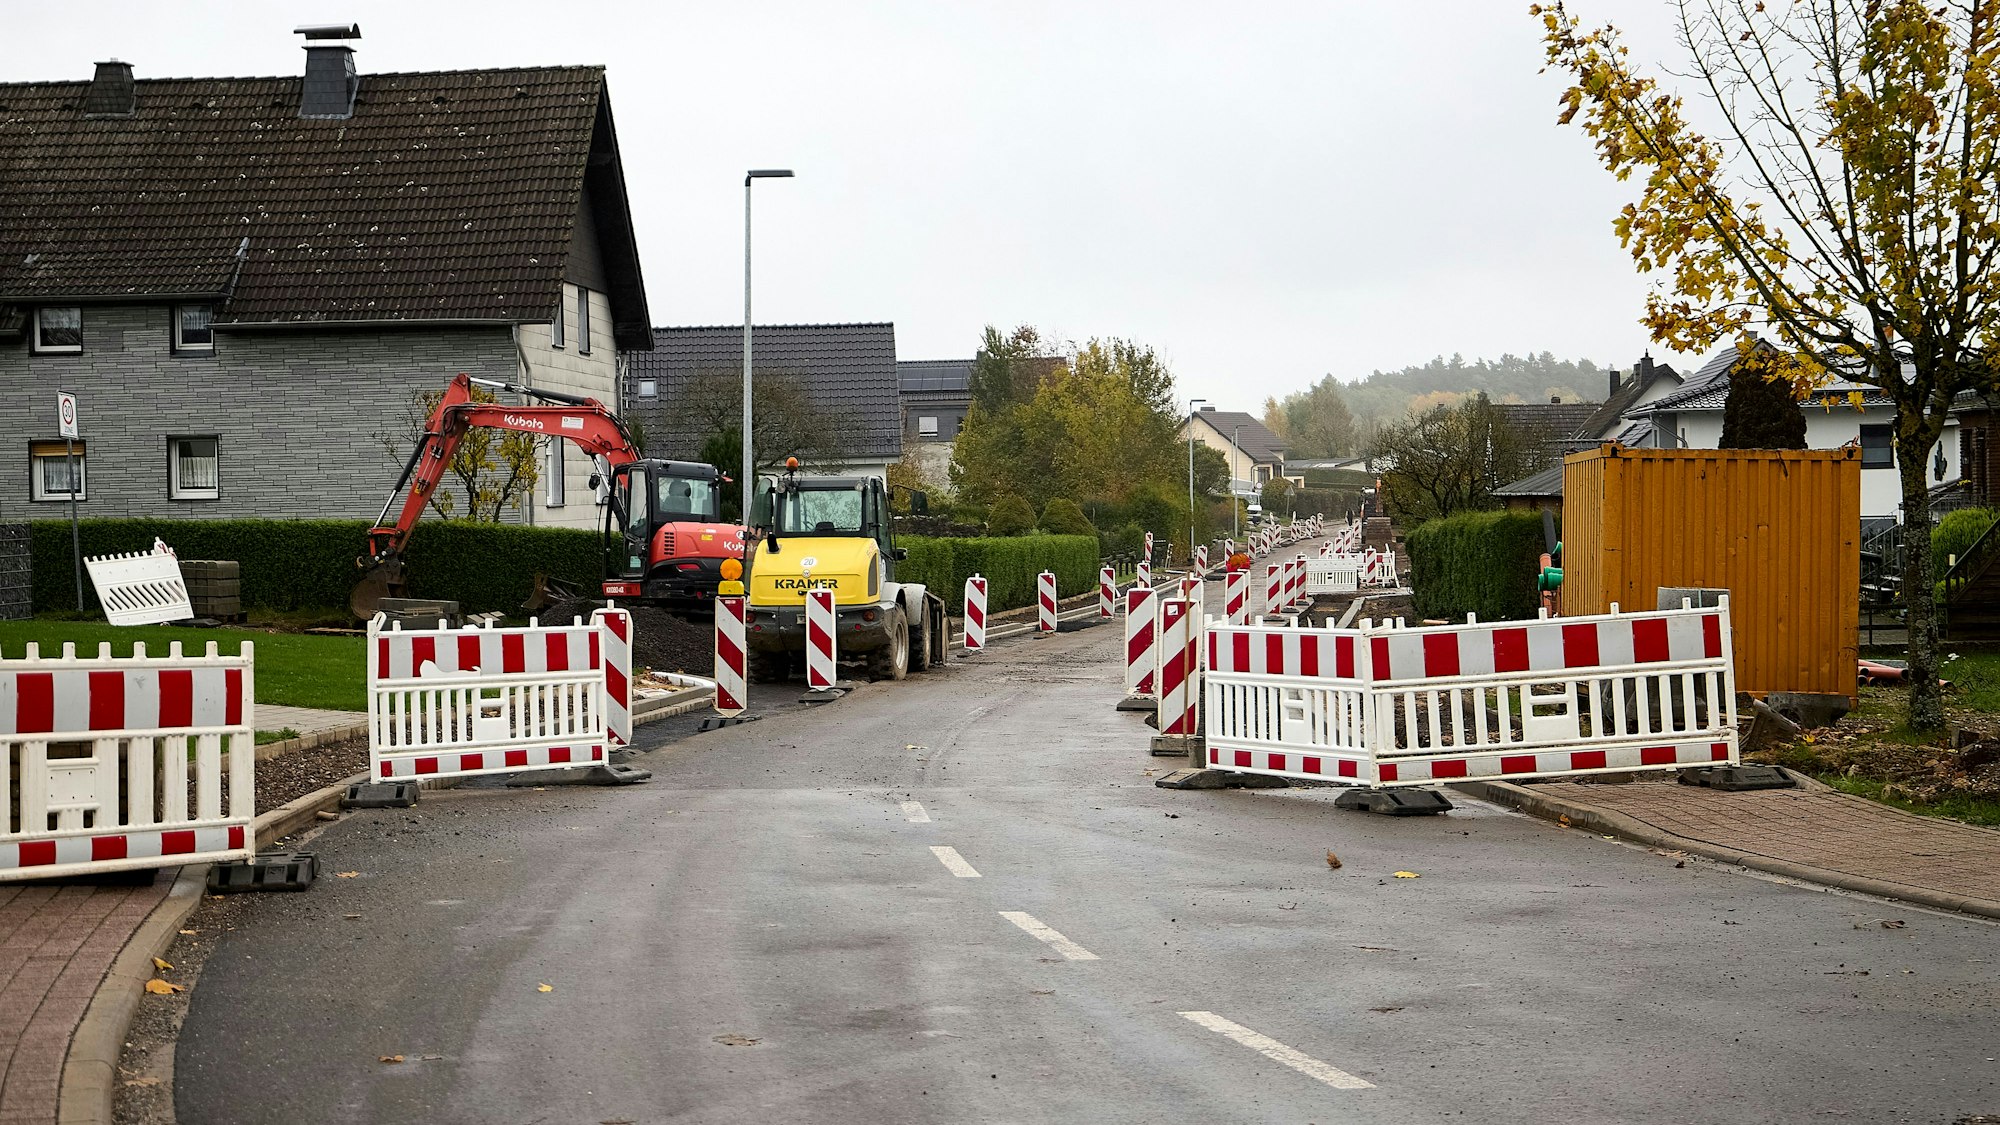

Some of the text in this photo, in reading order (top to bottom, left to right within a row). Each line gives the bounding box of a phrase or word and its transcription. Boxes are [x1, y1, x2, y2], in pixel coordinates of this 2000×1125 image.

[64, 405, 72, 418] 30
[504, 414, 543, 429] Kubota
[64, 425, 74, 434] ZONE
[804, 558, 814, 566] 20
[774, 579, 838, 589] KRAMER
